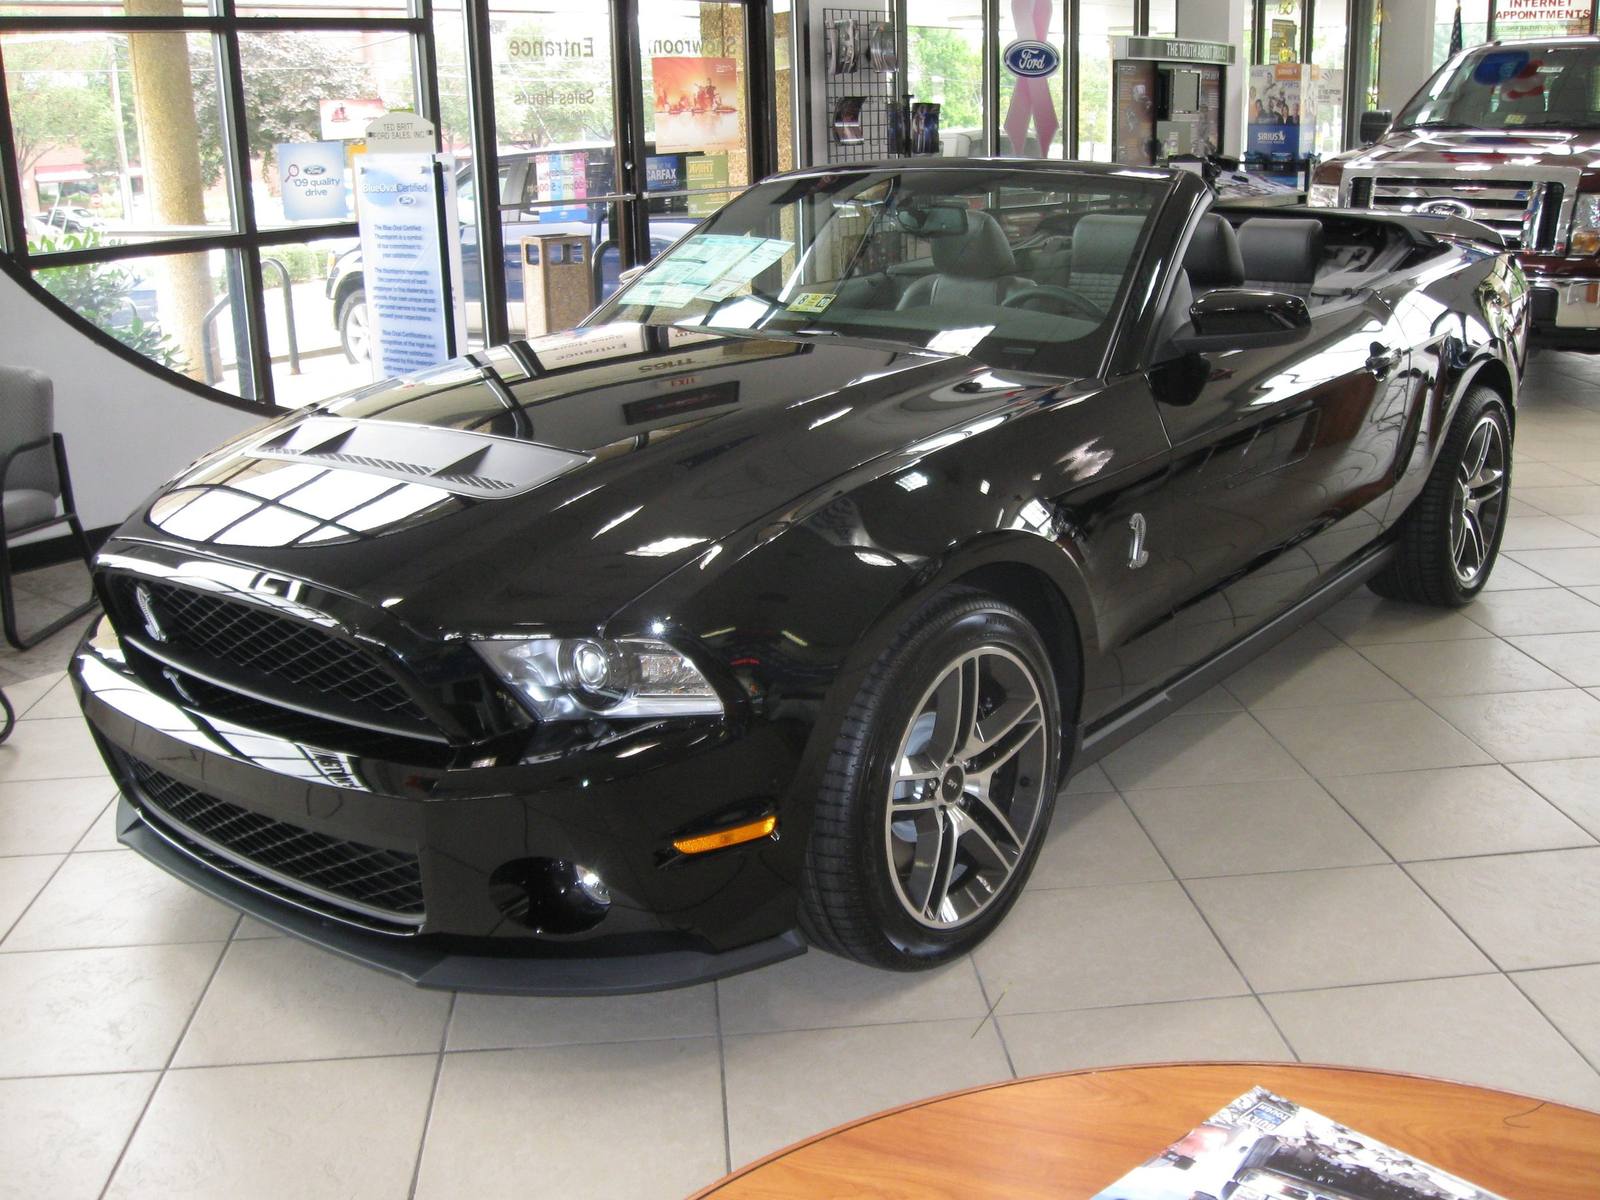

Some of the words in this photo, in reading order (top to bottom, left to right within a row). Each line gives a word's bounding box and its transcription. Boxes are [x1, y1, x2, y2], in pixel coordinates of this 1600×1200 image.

[1510, 0, 1572, 8] INTERNET
[1496, 9, 1591, 20] APPOINTMENTS
[1167, 42, 1179, 57] THE
[1180, 43, 1197, 58] TRUTH
[1198, 44, 1213, 59] ABOUT
[1018, 48, 1046, 70] Ford
[384, 123, 395, 132] TED
[397, 122, 415, 132] BRITT
[1257, 132, 1280, 141] SIRIUS
[647, 168, 677, 182] CARFAX
[293, 178, 309, 187] '09
[310, 178, 341, 188] quality
[304, 187, 328, 197] drive
